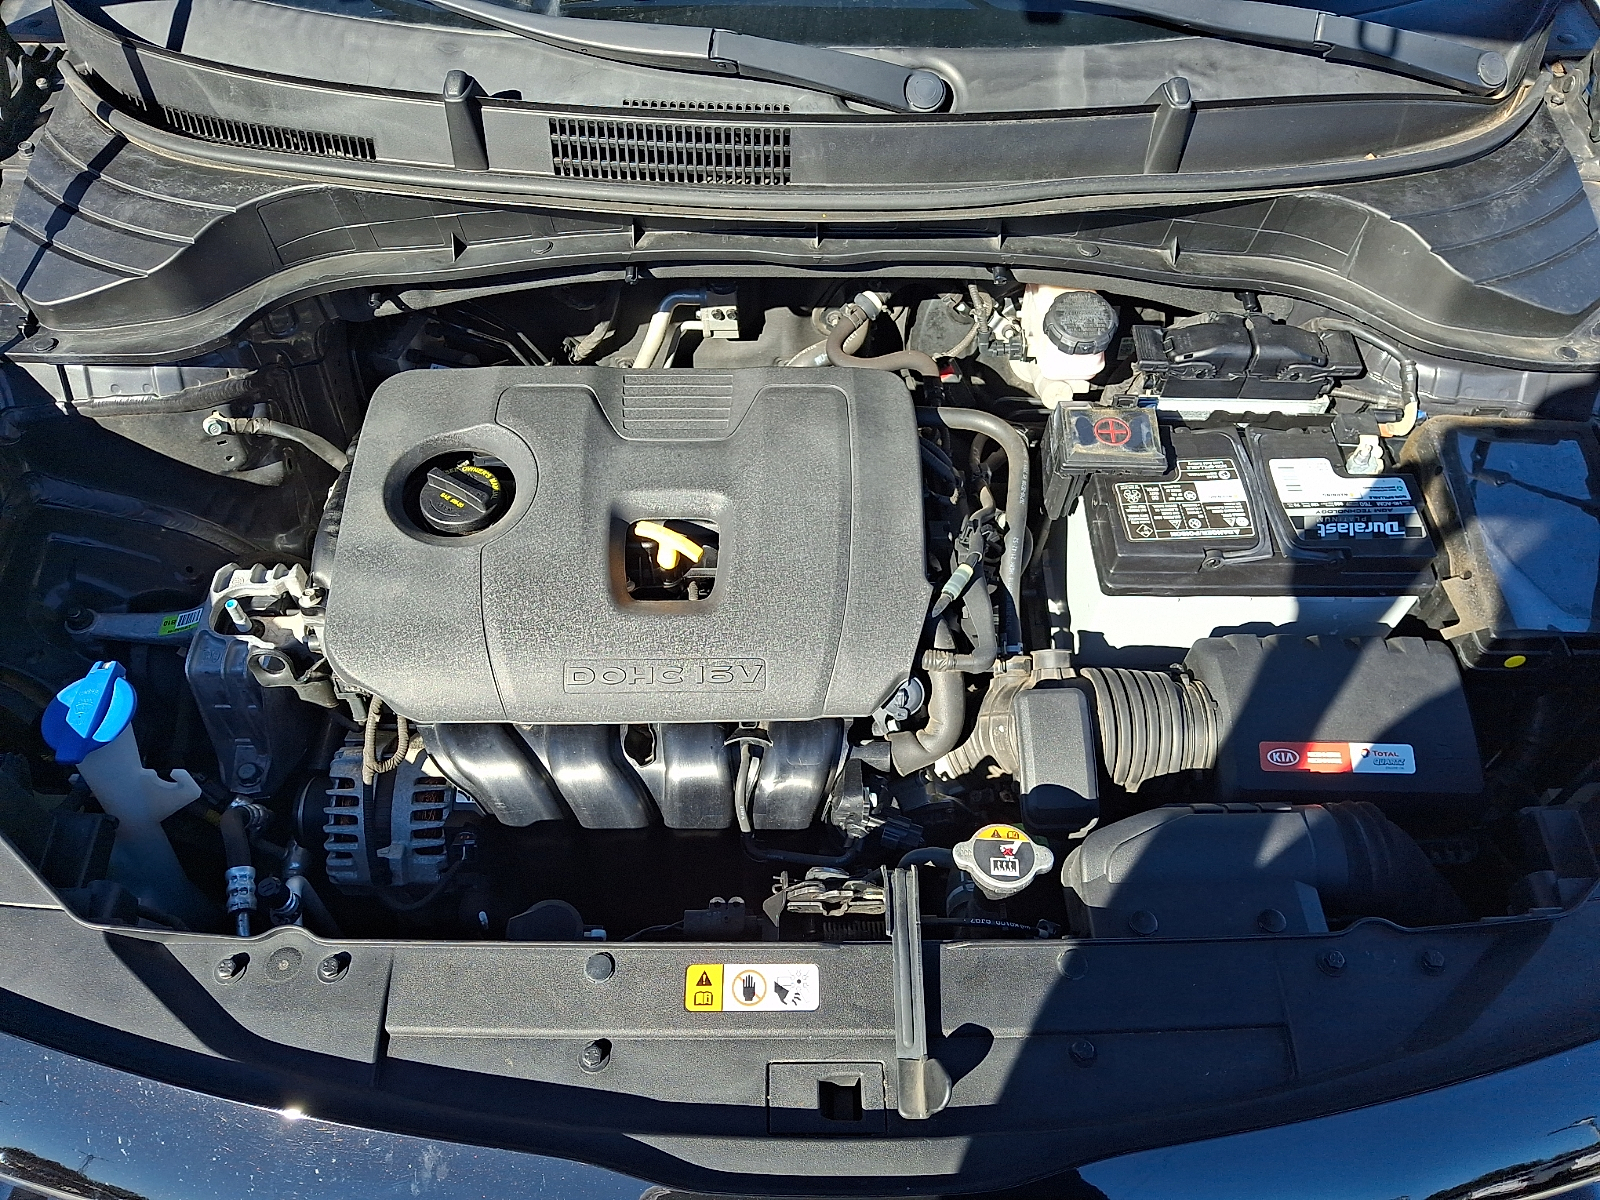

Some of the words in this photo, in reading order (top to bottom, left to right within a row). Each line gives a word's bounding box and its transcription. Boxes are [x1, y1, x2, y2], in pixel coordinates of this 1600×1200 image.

[1316, 521, 1405, 537] Duralast
[567, 666, 684, 685] DOHC
[696, 664, 763, 684] 16V
[1272, 752, 1294, 763] KIA
[1373, 758, 1406, 766] QUARTZ
